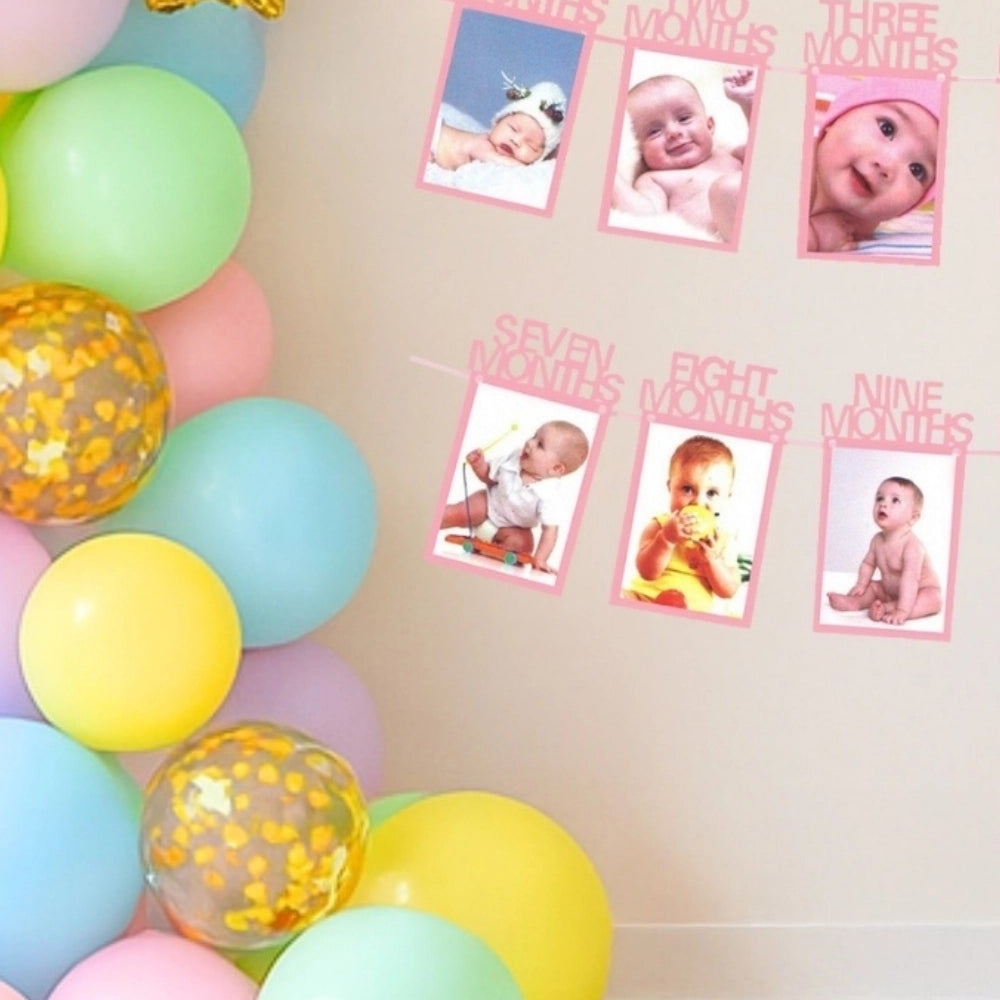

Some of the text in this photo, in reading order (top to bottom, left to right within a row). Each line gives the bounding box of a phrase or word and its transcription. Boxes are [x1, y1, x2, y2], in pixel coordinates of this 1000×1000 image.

[624, 4, 778, 56] MONTHS
[804, 32, 958, 72] MONTHS
[493, 313, 616, 371] SEVEN
[468, 339, 626, 404] MONTHS
[670, 351, 778, 397] EIGHT
[853, 373, 943, 411] NINE
[639, 379, 794, 435] MONTHS
[821, 402, 975, 446] MONTHS
